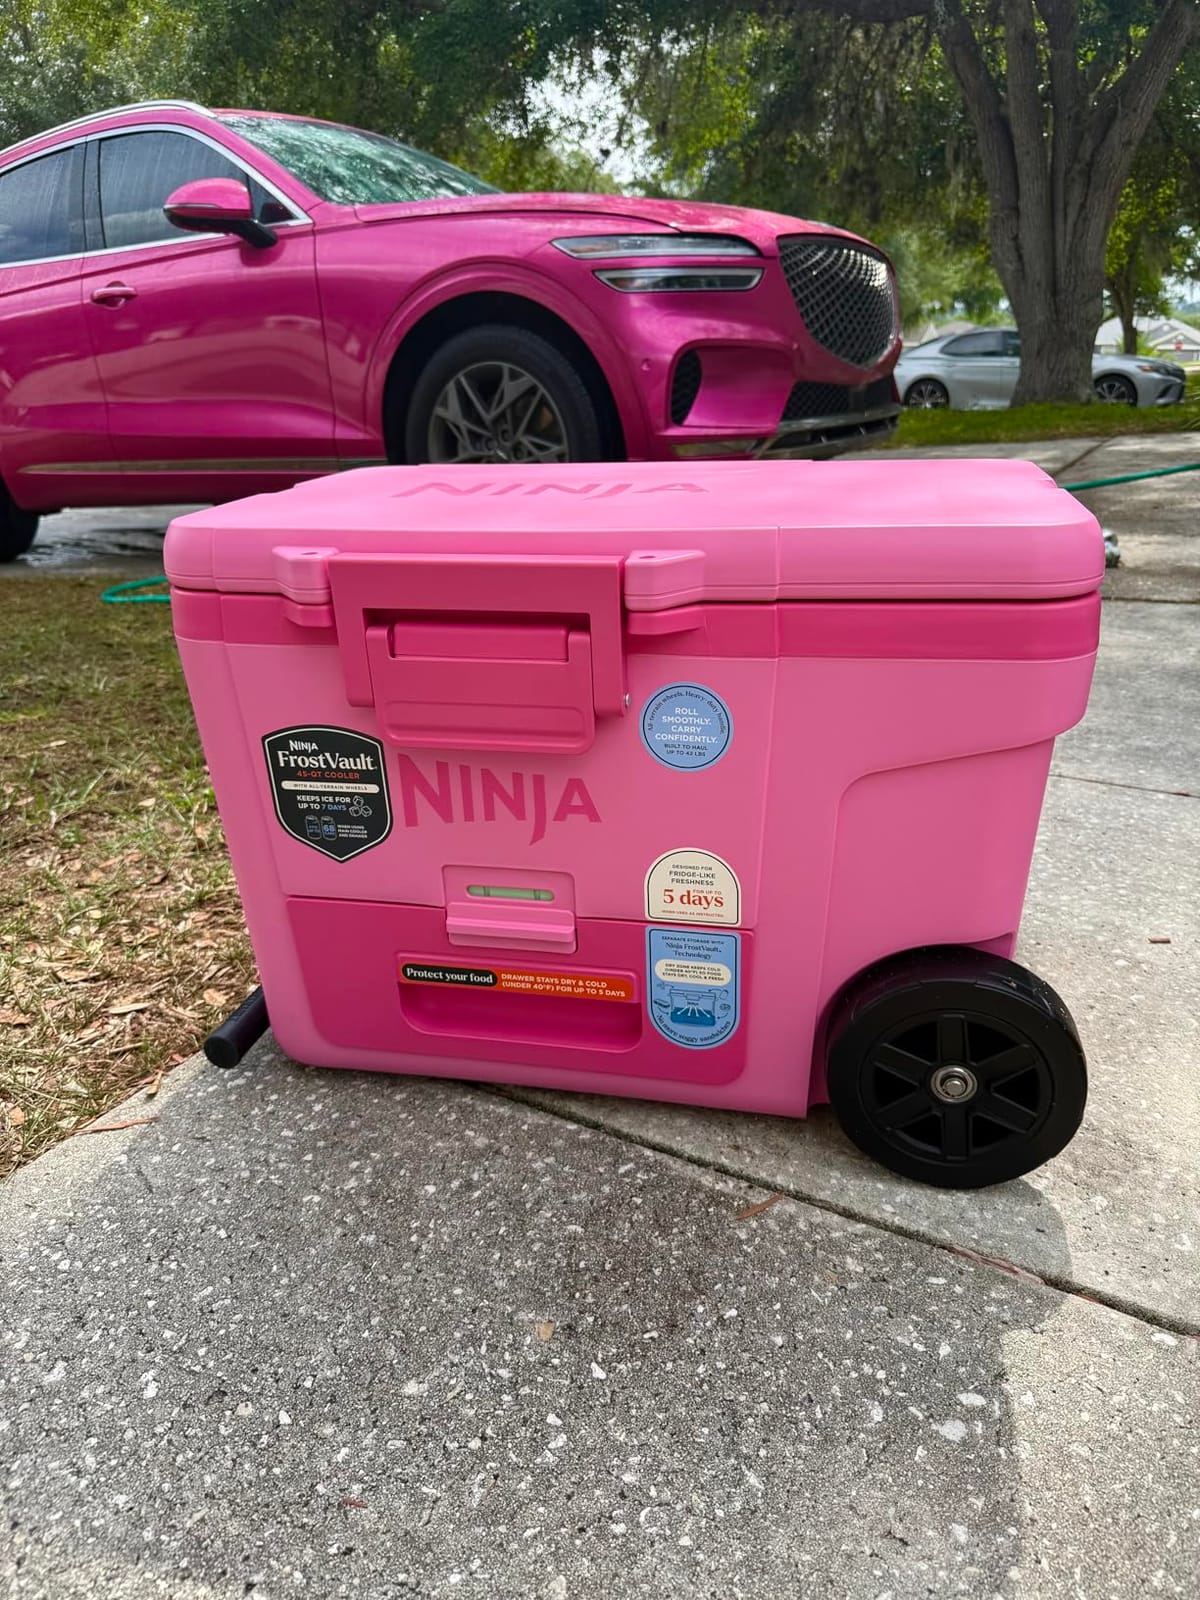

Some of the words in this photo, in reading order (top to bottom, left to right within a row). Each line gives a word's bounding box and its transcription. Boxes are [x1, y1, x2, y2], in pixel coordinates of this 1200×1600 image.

[390, 482, 709, 500] NINJA
[674, 707, 699, 716] ROLL
[661, 715, 712, 726] SMOOTHLY.
[671, 725, 702, 734] CARRY
[655, 733, 718, 744] CONFIDENTLY.
[289, 740, 319, 753] NINJA
[277, 750, 376, 771] FrostVault
[296, 770, 322, 779] 45-QT
[324, 771, 360, 780] COOLER
[296, 794, 320, 802] KEEPS
[335, 796, 352, 804] FOR
[397, 752, 602, 847] NINJA
[669, 870, 716, 879] FRIDGE-LIKE
[671, 878, 714, 886] FRESHNESS
[663, 888, 674, 904] 5
[680, 890, 724, 910] days
[674, 950, 712, 960] Technology
[406, 968, 442, 980] Protect
[446, 972, 469, 982] your
[470, 972, 494, 984] food
[502, 974, 535, 982] DRAWER
[536, 976, 560, 984] STAYS
[561, 978, 578, 986] DRY
[586, 980, 608, 988] COLD
[502, 981, 532, 989] (UNDER
[605, 990, 626, 998] DAYS
